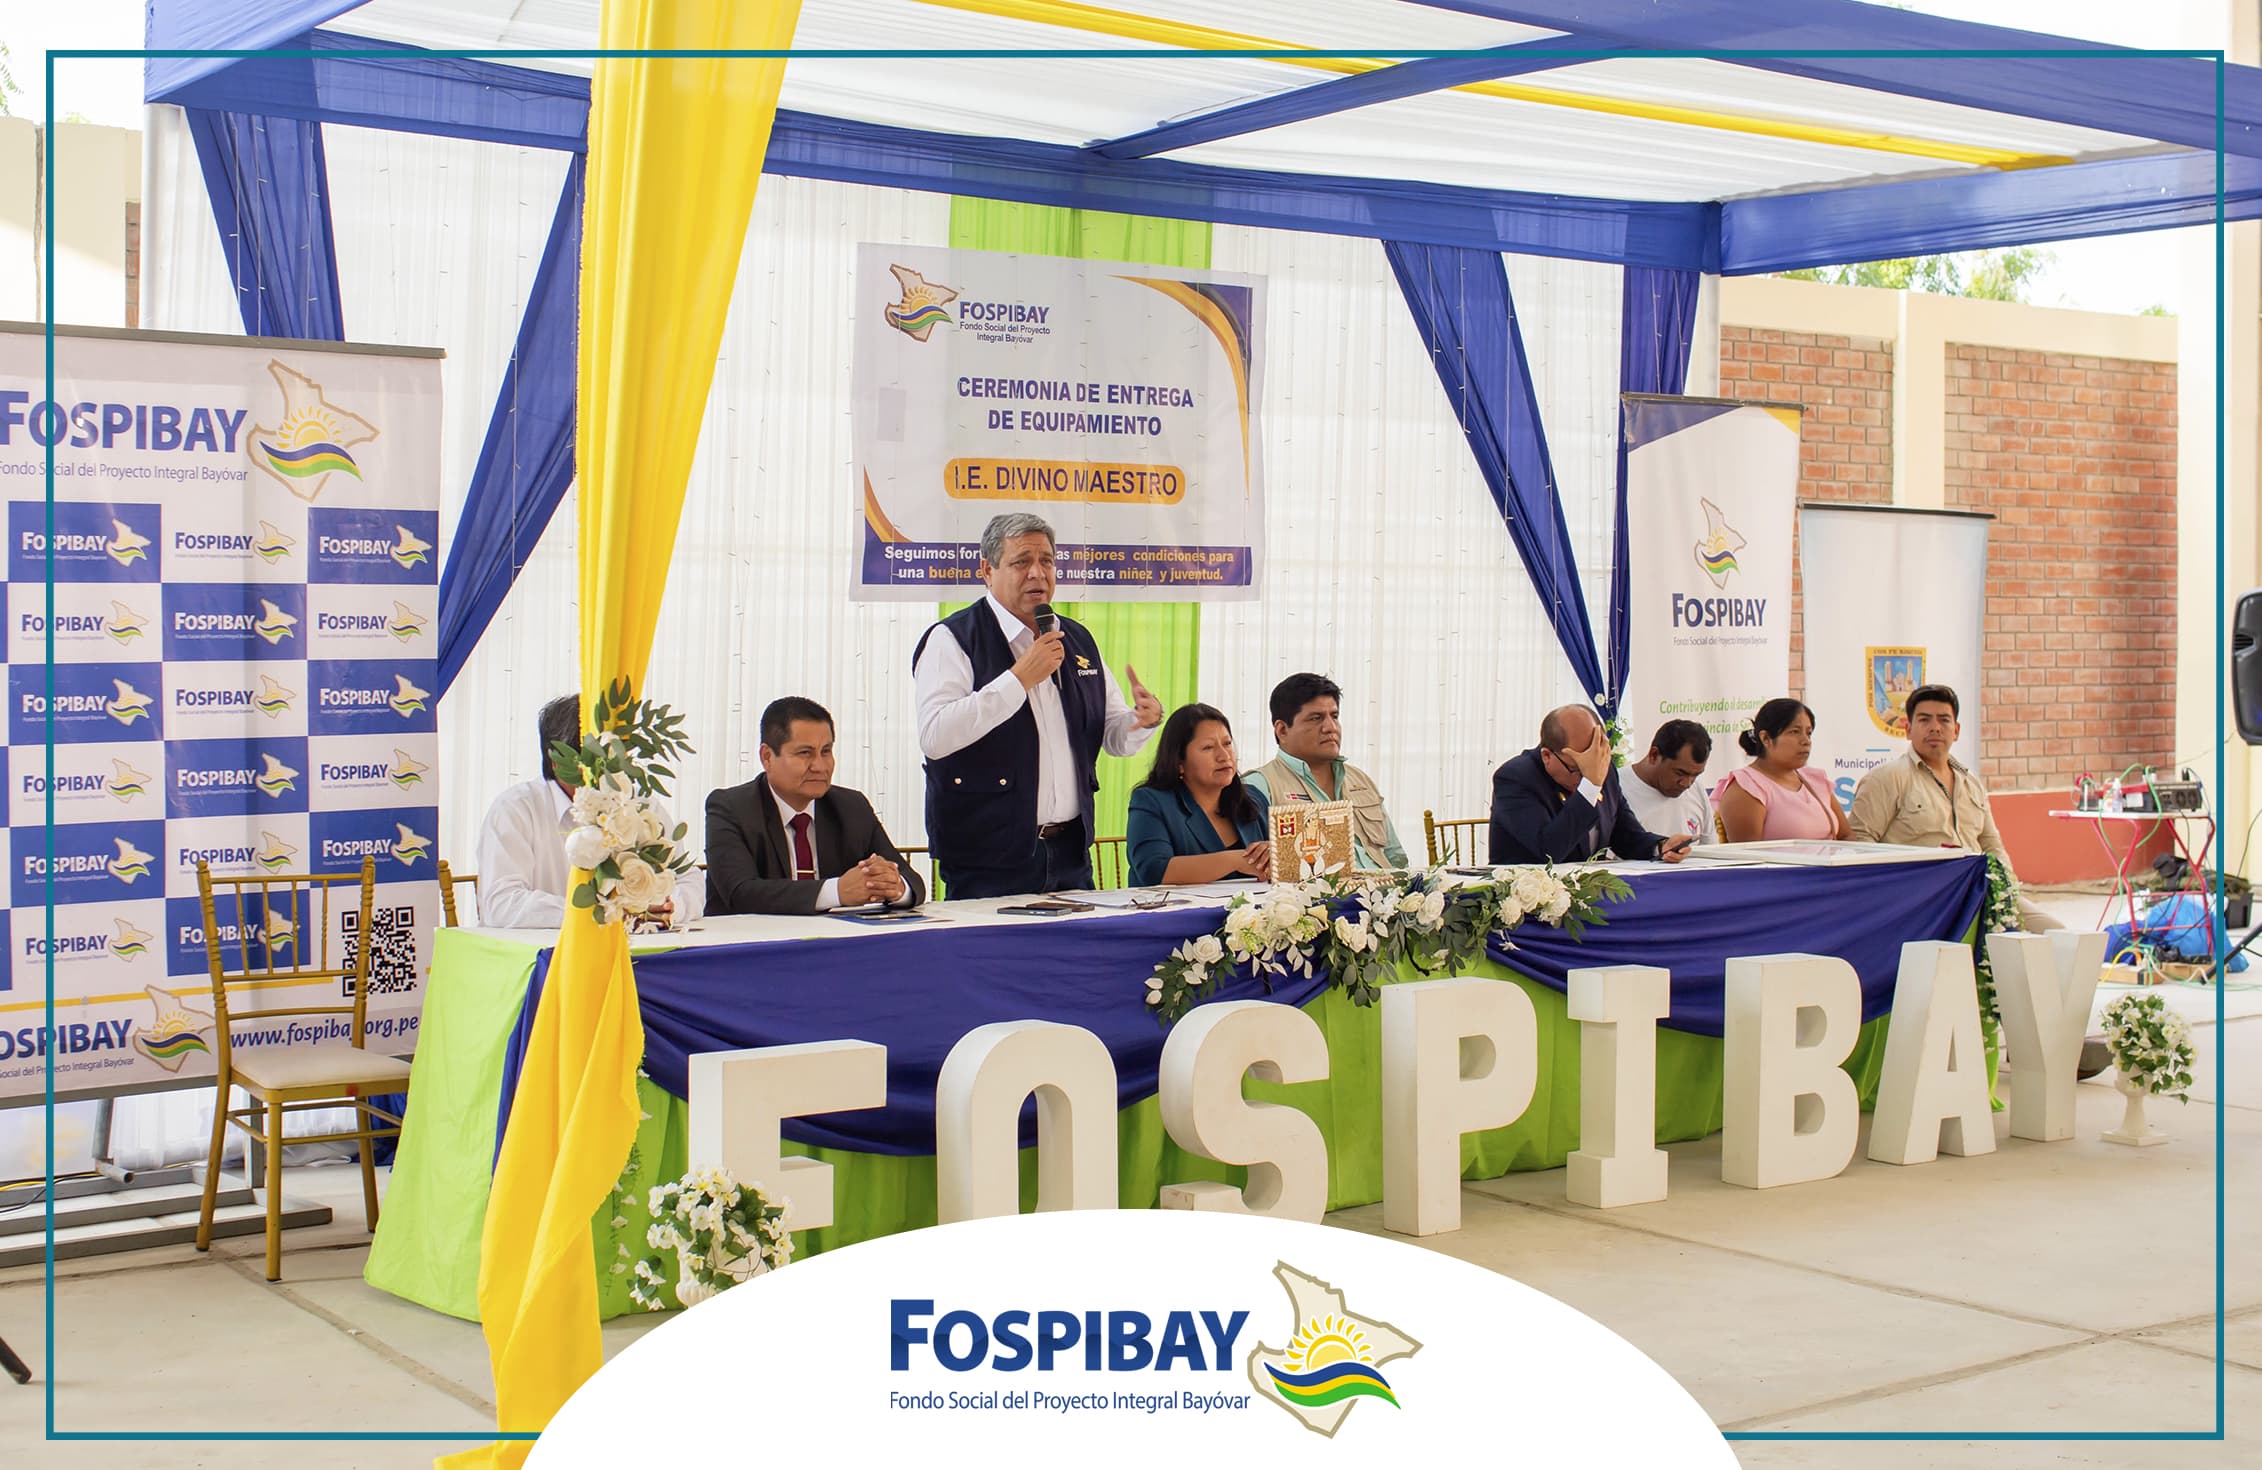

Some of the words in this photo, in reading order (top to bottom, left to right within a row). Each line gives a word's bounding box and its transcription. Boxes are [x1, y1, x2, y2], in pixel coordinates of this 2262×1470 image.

[960, 301, 1050, 324] FOSPIBAY
[960, 321, 983, 331] Fondo
[984, 322, 1007, 333] Social
[1007, 324, 1019, 333] del
[1020, 325, 1051, 336] Proyecto
[976, 333, 1004, 344] Integral
[957, 376, 1072, 402] CEREMONIA
[1076, 383, 1101, 403] DE
[1107, 384, 1194, 408] ENTREGA
[0, 390, 249, 453] FOSPIBAY
[987, 409, 1014, 431] DE
[1020, 410, 1162, 436] EQUIPAMIENTO
[39, 462, 75, 477] Scial
[78, 463, 97, 477] del
[100, 463, 152, 481] Proyecto
[154, 465, 199, 483] Integral
[201, 466, 249, 484] Bayóvar
[954, 465, 988, 490] I.E.
[996, 466, 1069, 492] DIVINO
[1073, 469, 1177, 496] MAESTRO
[22, 532, 107, 552] FOPIBAY
[175, 531, 253, 551] FOSPIBAY
[319, 536, 391, 556] FOSPIBAY
[884, 545, 956, 563] Seguimos
[1055, 550, 1070, 561] as
[1133, 548, 1206, 564] condiciones
[1208, 551, 1235, 566] para
[898, 568, 924, 580] una
[928, 566, 972, 580] buena
[1066, 567, 1115, 580] nuestra
[1119, 567, 1153, 581] niñez
[1159, 570, 1167, 583] y
[1169, 568, 1224, 583] juventud.
[1672, 593, 1767, 628] FOSPIBAY
[22, 613, 105, 632] FOPIBAY
[174, 612, 256, 632] FOSPIBAY
[318, 612, 388, 630] FOSPIBAY
[22, 694, 107, 713] FOPIBAY
[176, 688, 254, 706] FOSPIBAY
[320, 688, 391, 706] FOSPIBAY
[320, 763, 389, 781] FOSPIBAY
[1834, 757, 1889, 771] Municip
[23, 775, 105, 794] FOPIBAY
[177, 768, 257, 788] FOSPIBAY
[180, 846, 257, 867] FOSPIBAY
[322, 838, 392, 858] FOSPIBAY
[230, 1014, 419, 1049] www.fospibaorg.pe
[22, 1065, 35, 1077] del
[36, 1063, 71, 1075] Precto
[72, 1060, 103, 1072] Integral
